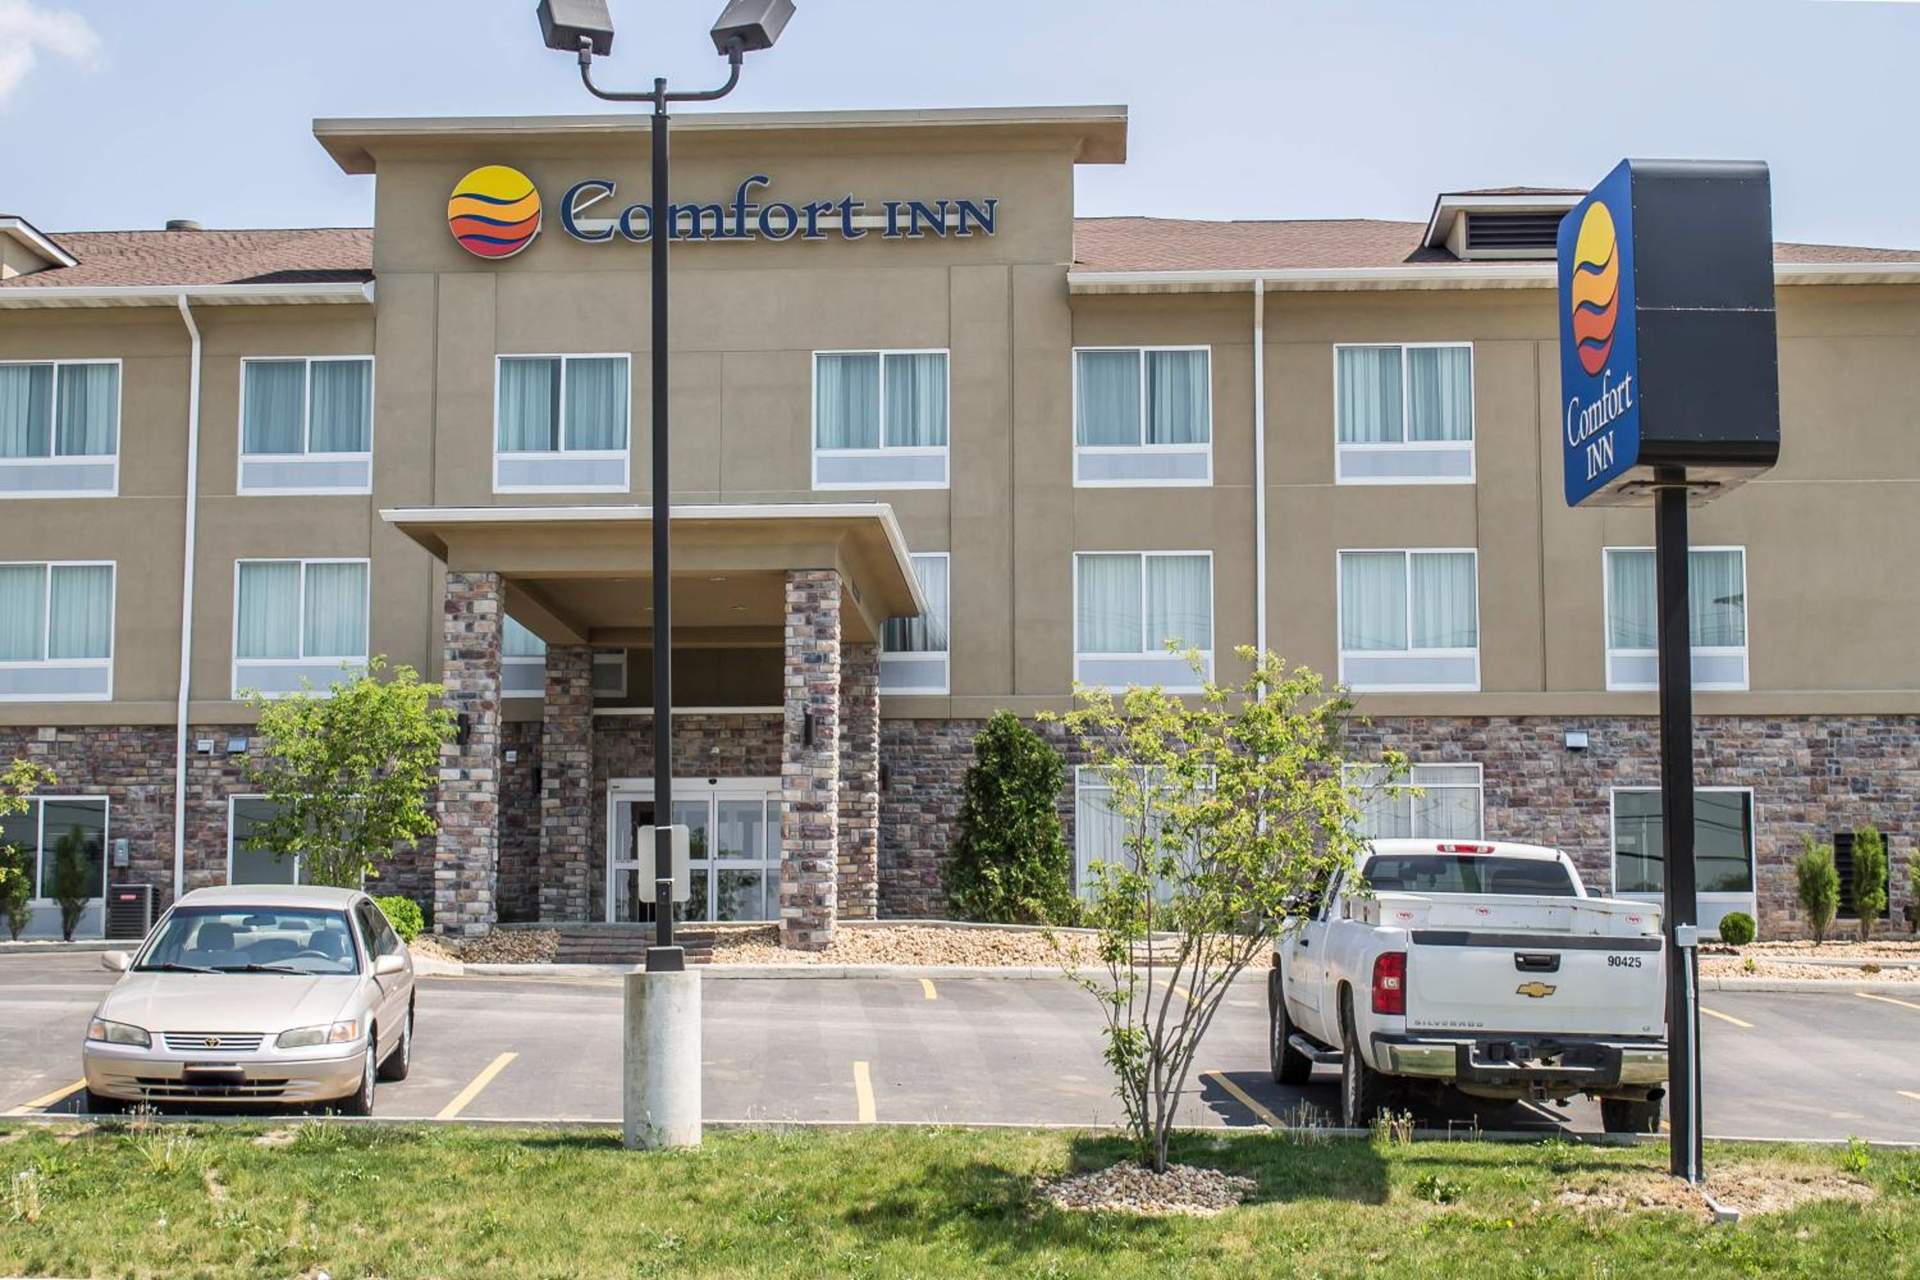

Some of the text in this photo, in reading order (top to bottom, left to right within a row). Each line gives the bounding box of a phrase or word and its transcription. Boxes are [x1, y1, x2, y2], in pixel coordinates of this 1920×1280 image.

[560, 174, 999, 243] Comfort INN
[1567, 368, 1633, 447] Comfort
[1586, 430, 1615, 481] INN
[1607, 955, 1642, 968] 90425
